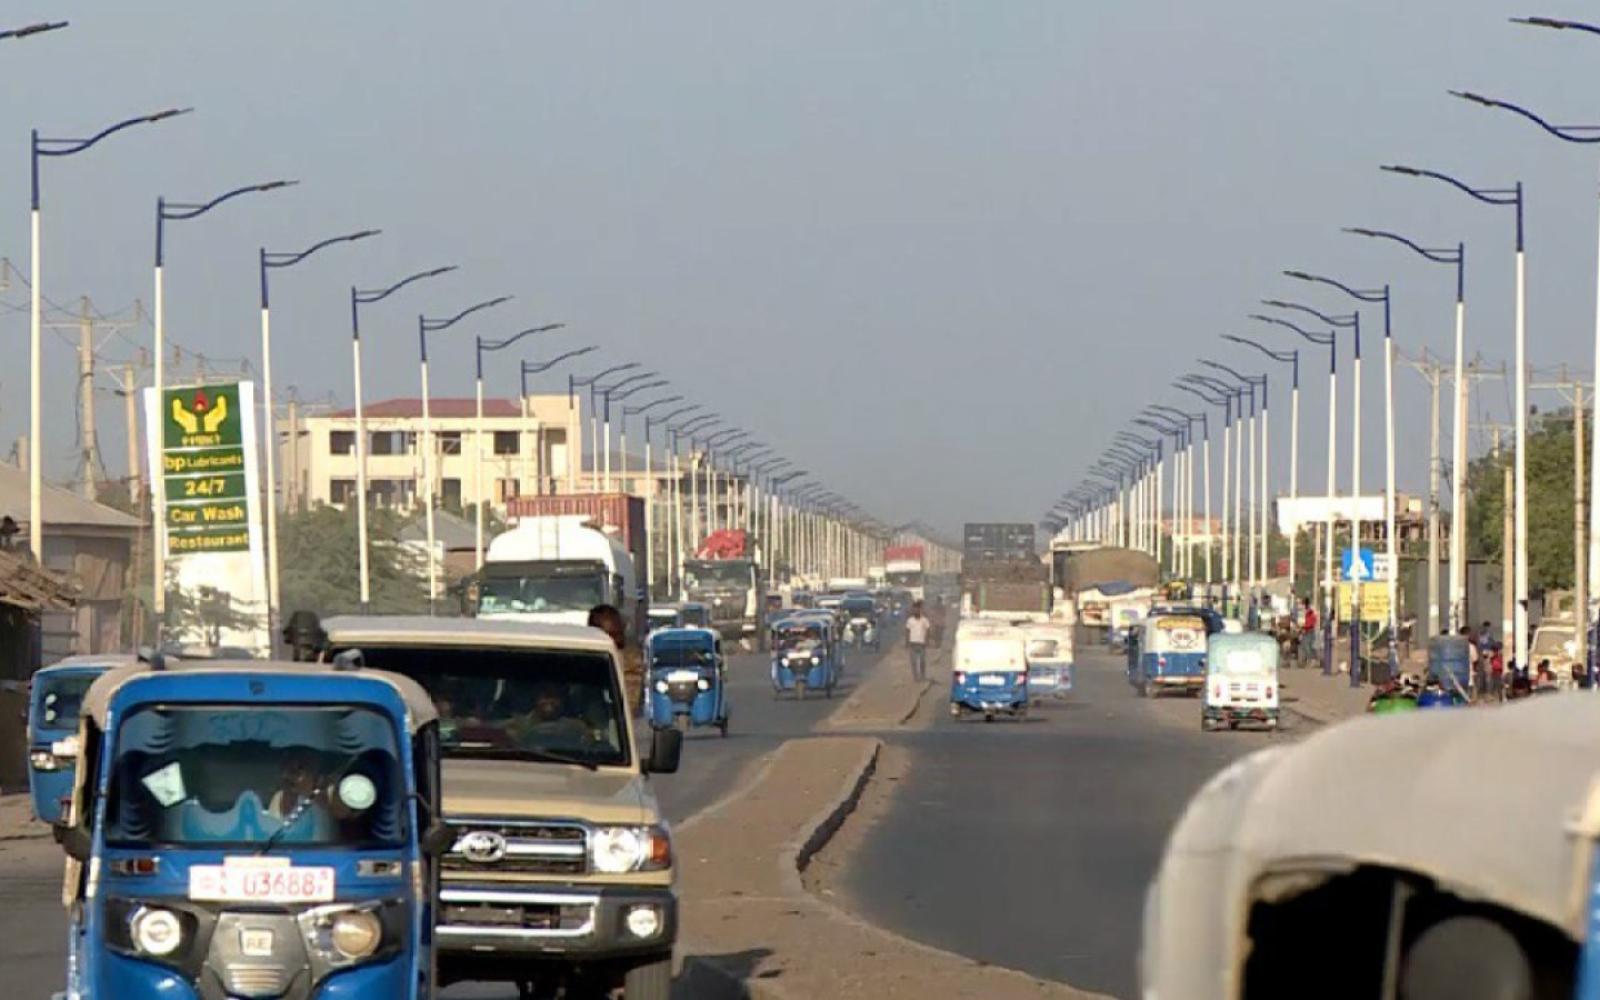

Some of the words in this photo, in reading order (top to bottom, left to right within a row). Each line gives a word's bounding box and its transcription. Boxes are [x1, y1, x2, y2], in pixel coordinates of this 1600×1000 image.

[185, 478, 225, 496] 24/7
[170, 509, 197, 522] Car
[202, 505, 244, 521] Wash
[170, 532, 248, 549] Restaurant
